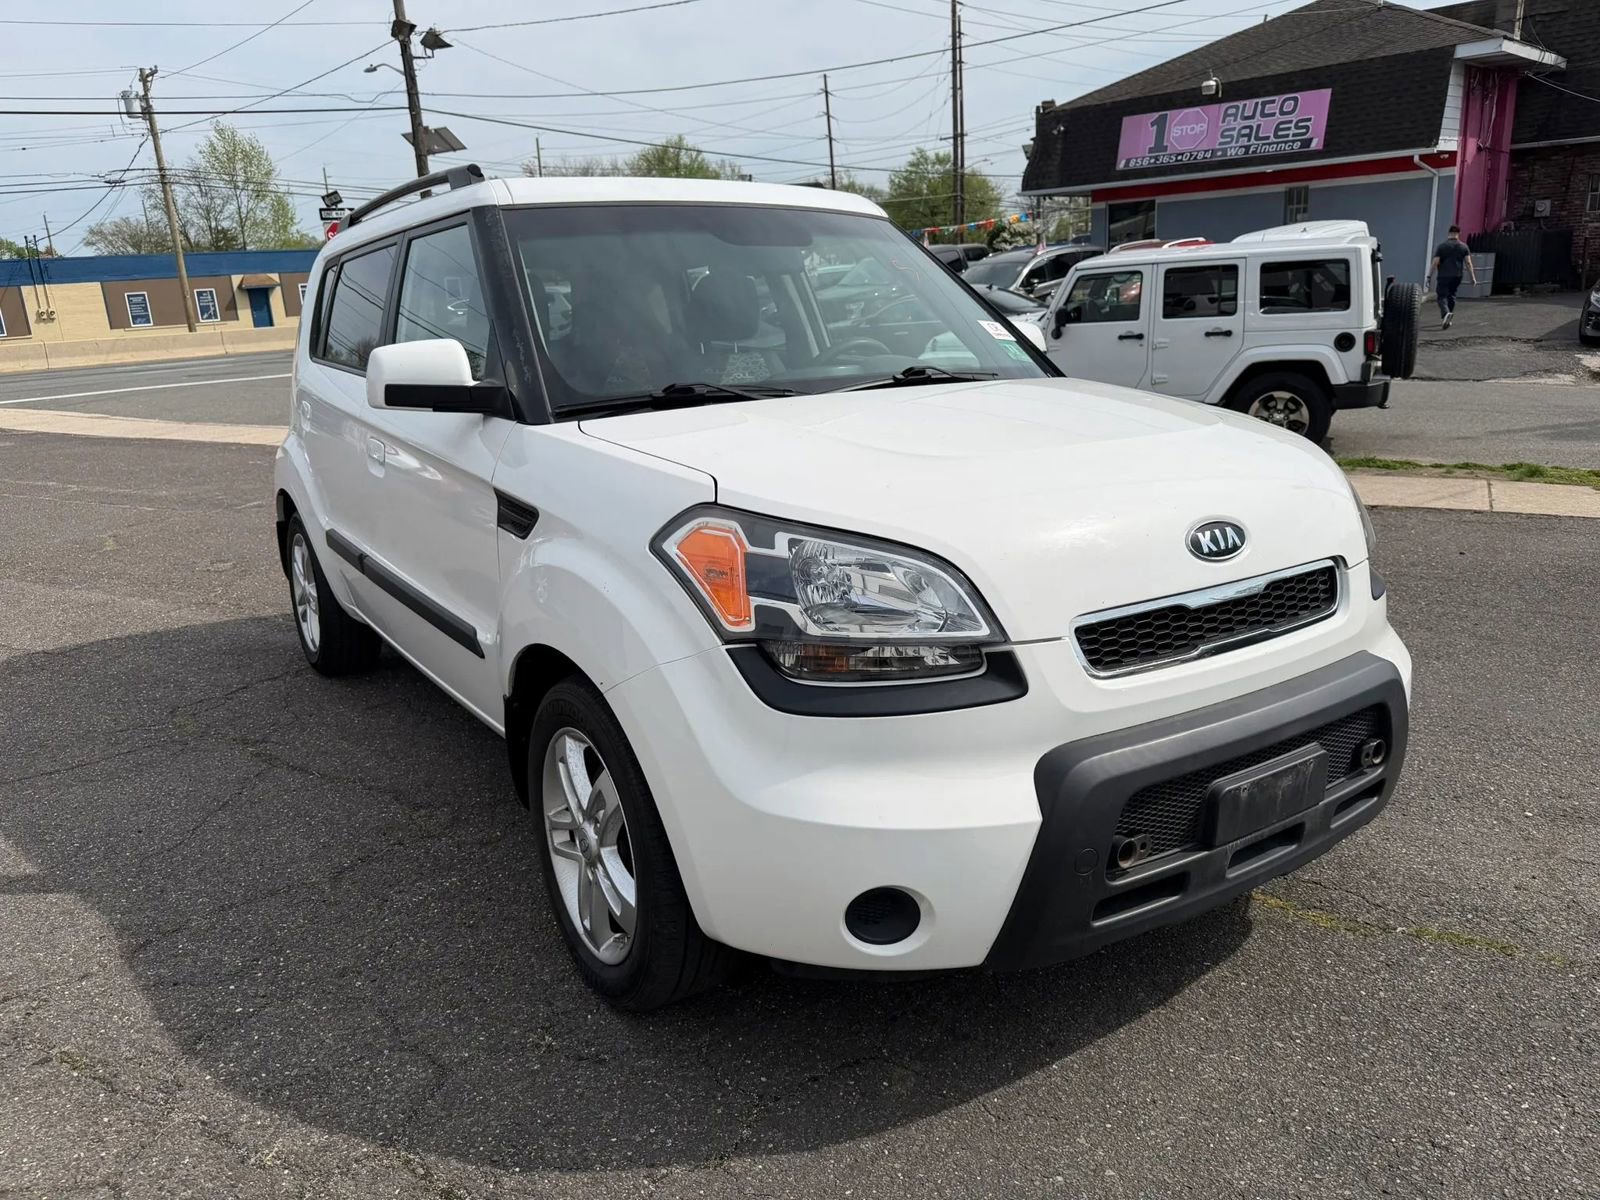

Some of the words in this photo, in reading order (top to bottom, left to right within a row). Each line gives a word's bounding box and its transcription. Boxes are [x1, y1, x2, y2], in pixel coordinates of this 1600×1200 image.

[1221, 95, 1300, 125] AUTO
[1147, 112, 1169, 155] 1
[1171, 123, 1207, 137] STOP
[1216, 116, 1313, 148] SALES
[1226, 145, 1246, 157] We
[1249, 140, 1302, 155] Finance
[1195, 526, 1242, 554] KIA
